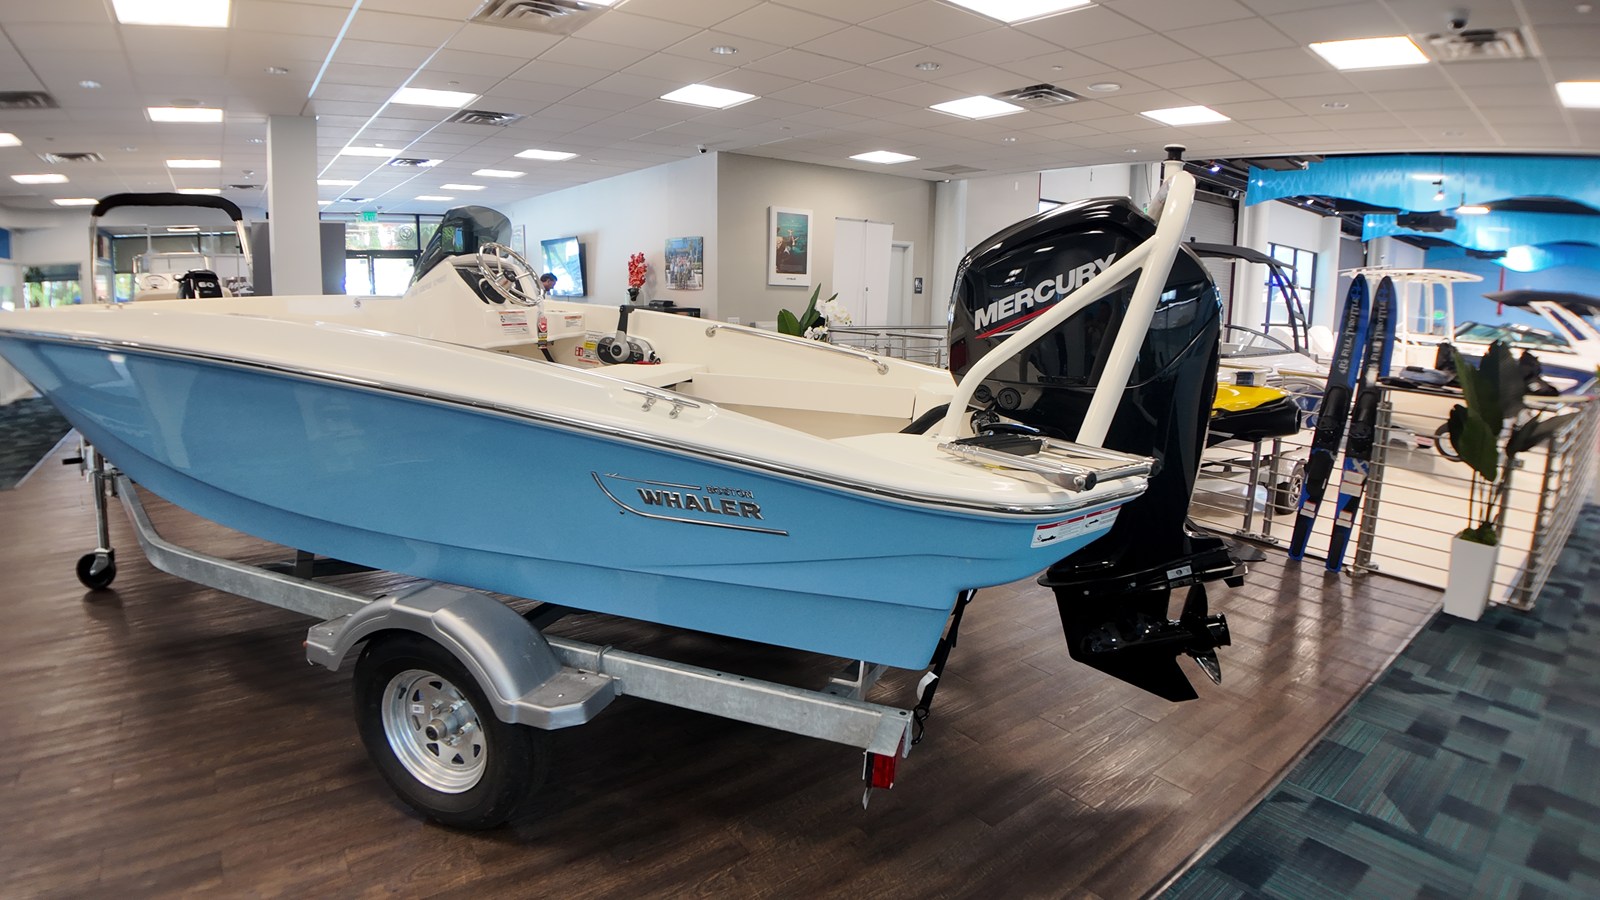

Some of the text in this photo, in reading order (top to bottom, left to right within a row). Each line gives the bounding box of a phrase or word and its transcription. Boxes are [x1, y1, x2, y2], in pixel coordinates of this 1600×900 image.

[974, 252, 1117, 331] MERCURY
[636, 488, 764, 520] WHALER
[706, 485, 754, 499] BOSTON
